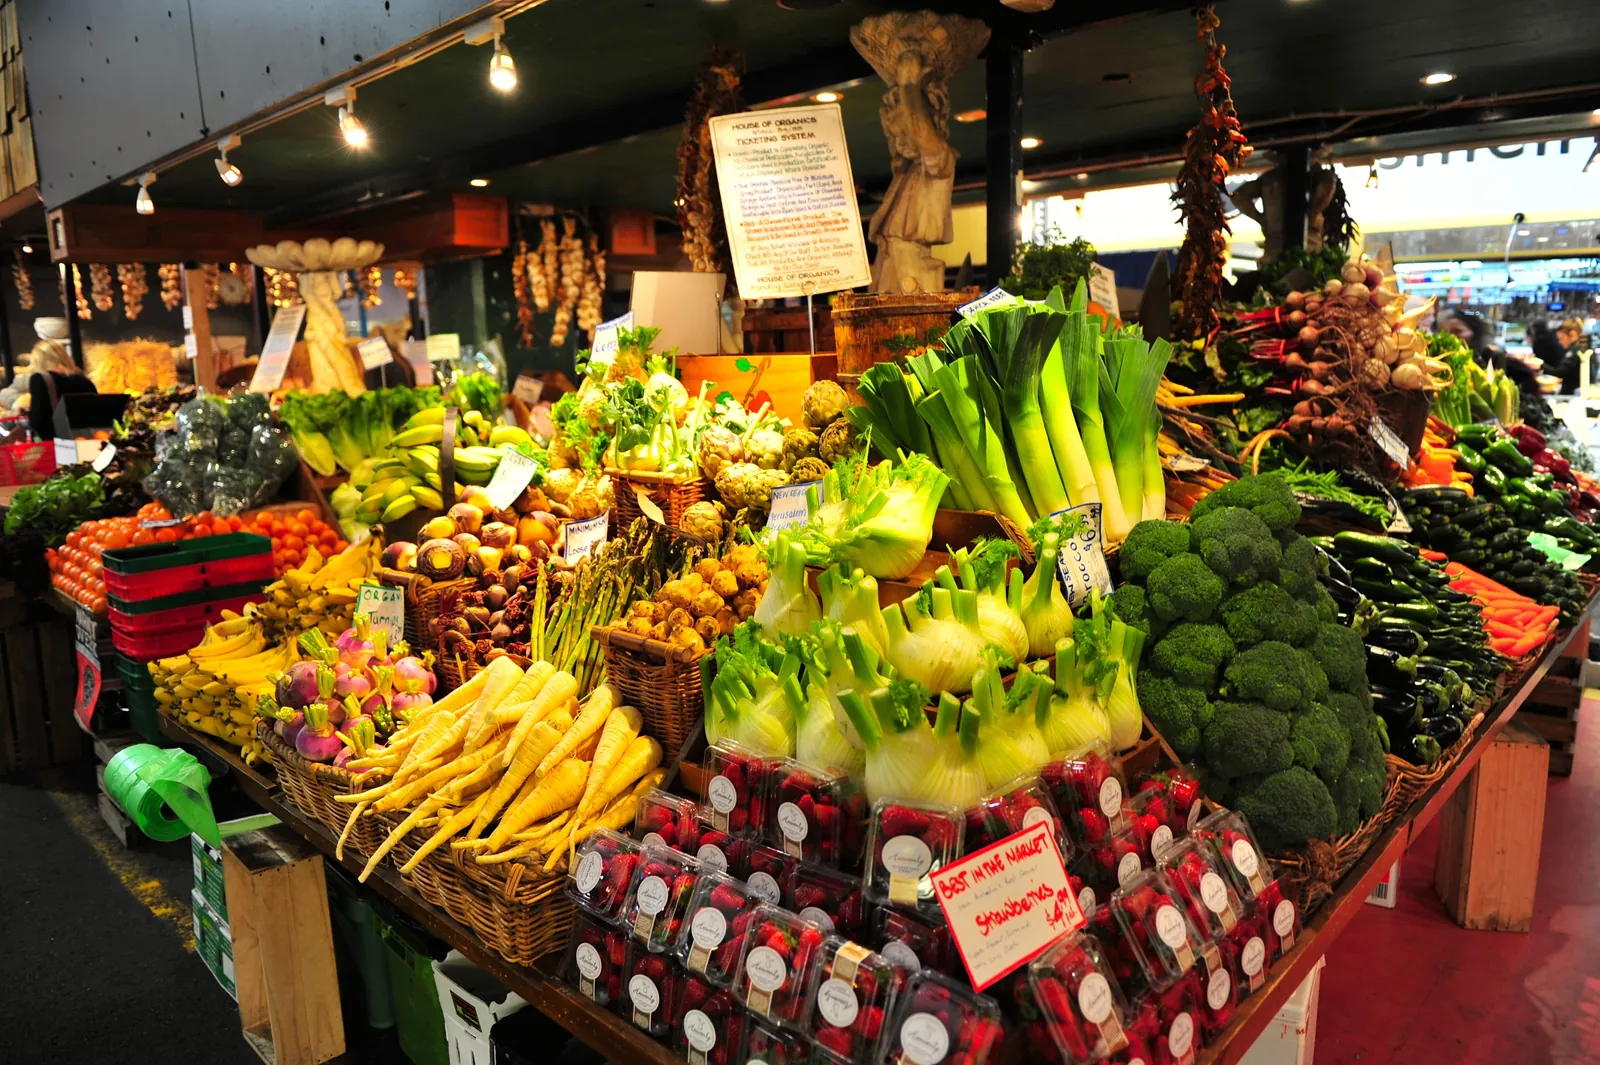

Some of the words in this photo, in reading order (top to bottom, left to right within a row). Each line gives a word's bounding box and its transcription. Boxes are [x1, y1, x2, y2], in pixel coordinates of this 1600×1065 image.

[731, 121, 760, 130] HOUSE
[774, 115, 817, 127] ORGANICS
[736, 134, 777, 145] TICKETING
[780, 131, 815, 141] SYSTEM
[757, 274, 783, 283] HOUSE
[797, 268, 840, 279] ORGANICS
[772, 490, 788, 500] NEW
[568, 544, 589, 556] Loose
[938, 869, 970, 900] BEST
[983, 853, 1005, 878] THE
[1005, 832, 1049, 864] MARKET
[975, 879, 1055, 937] Strawberries
